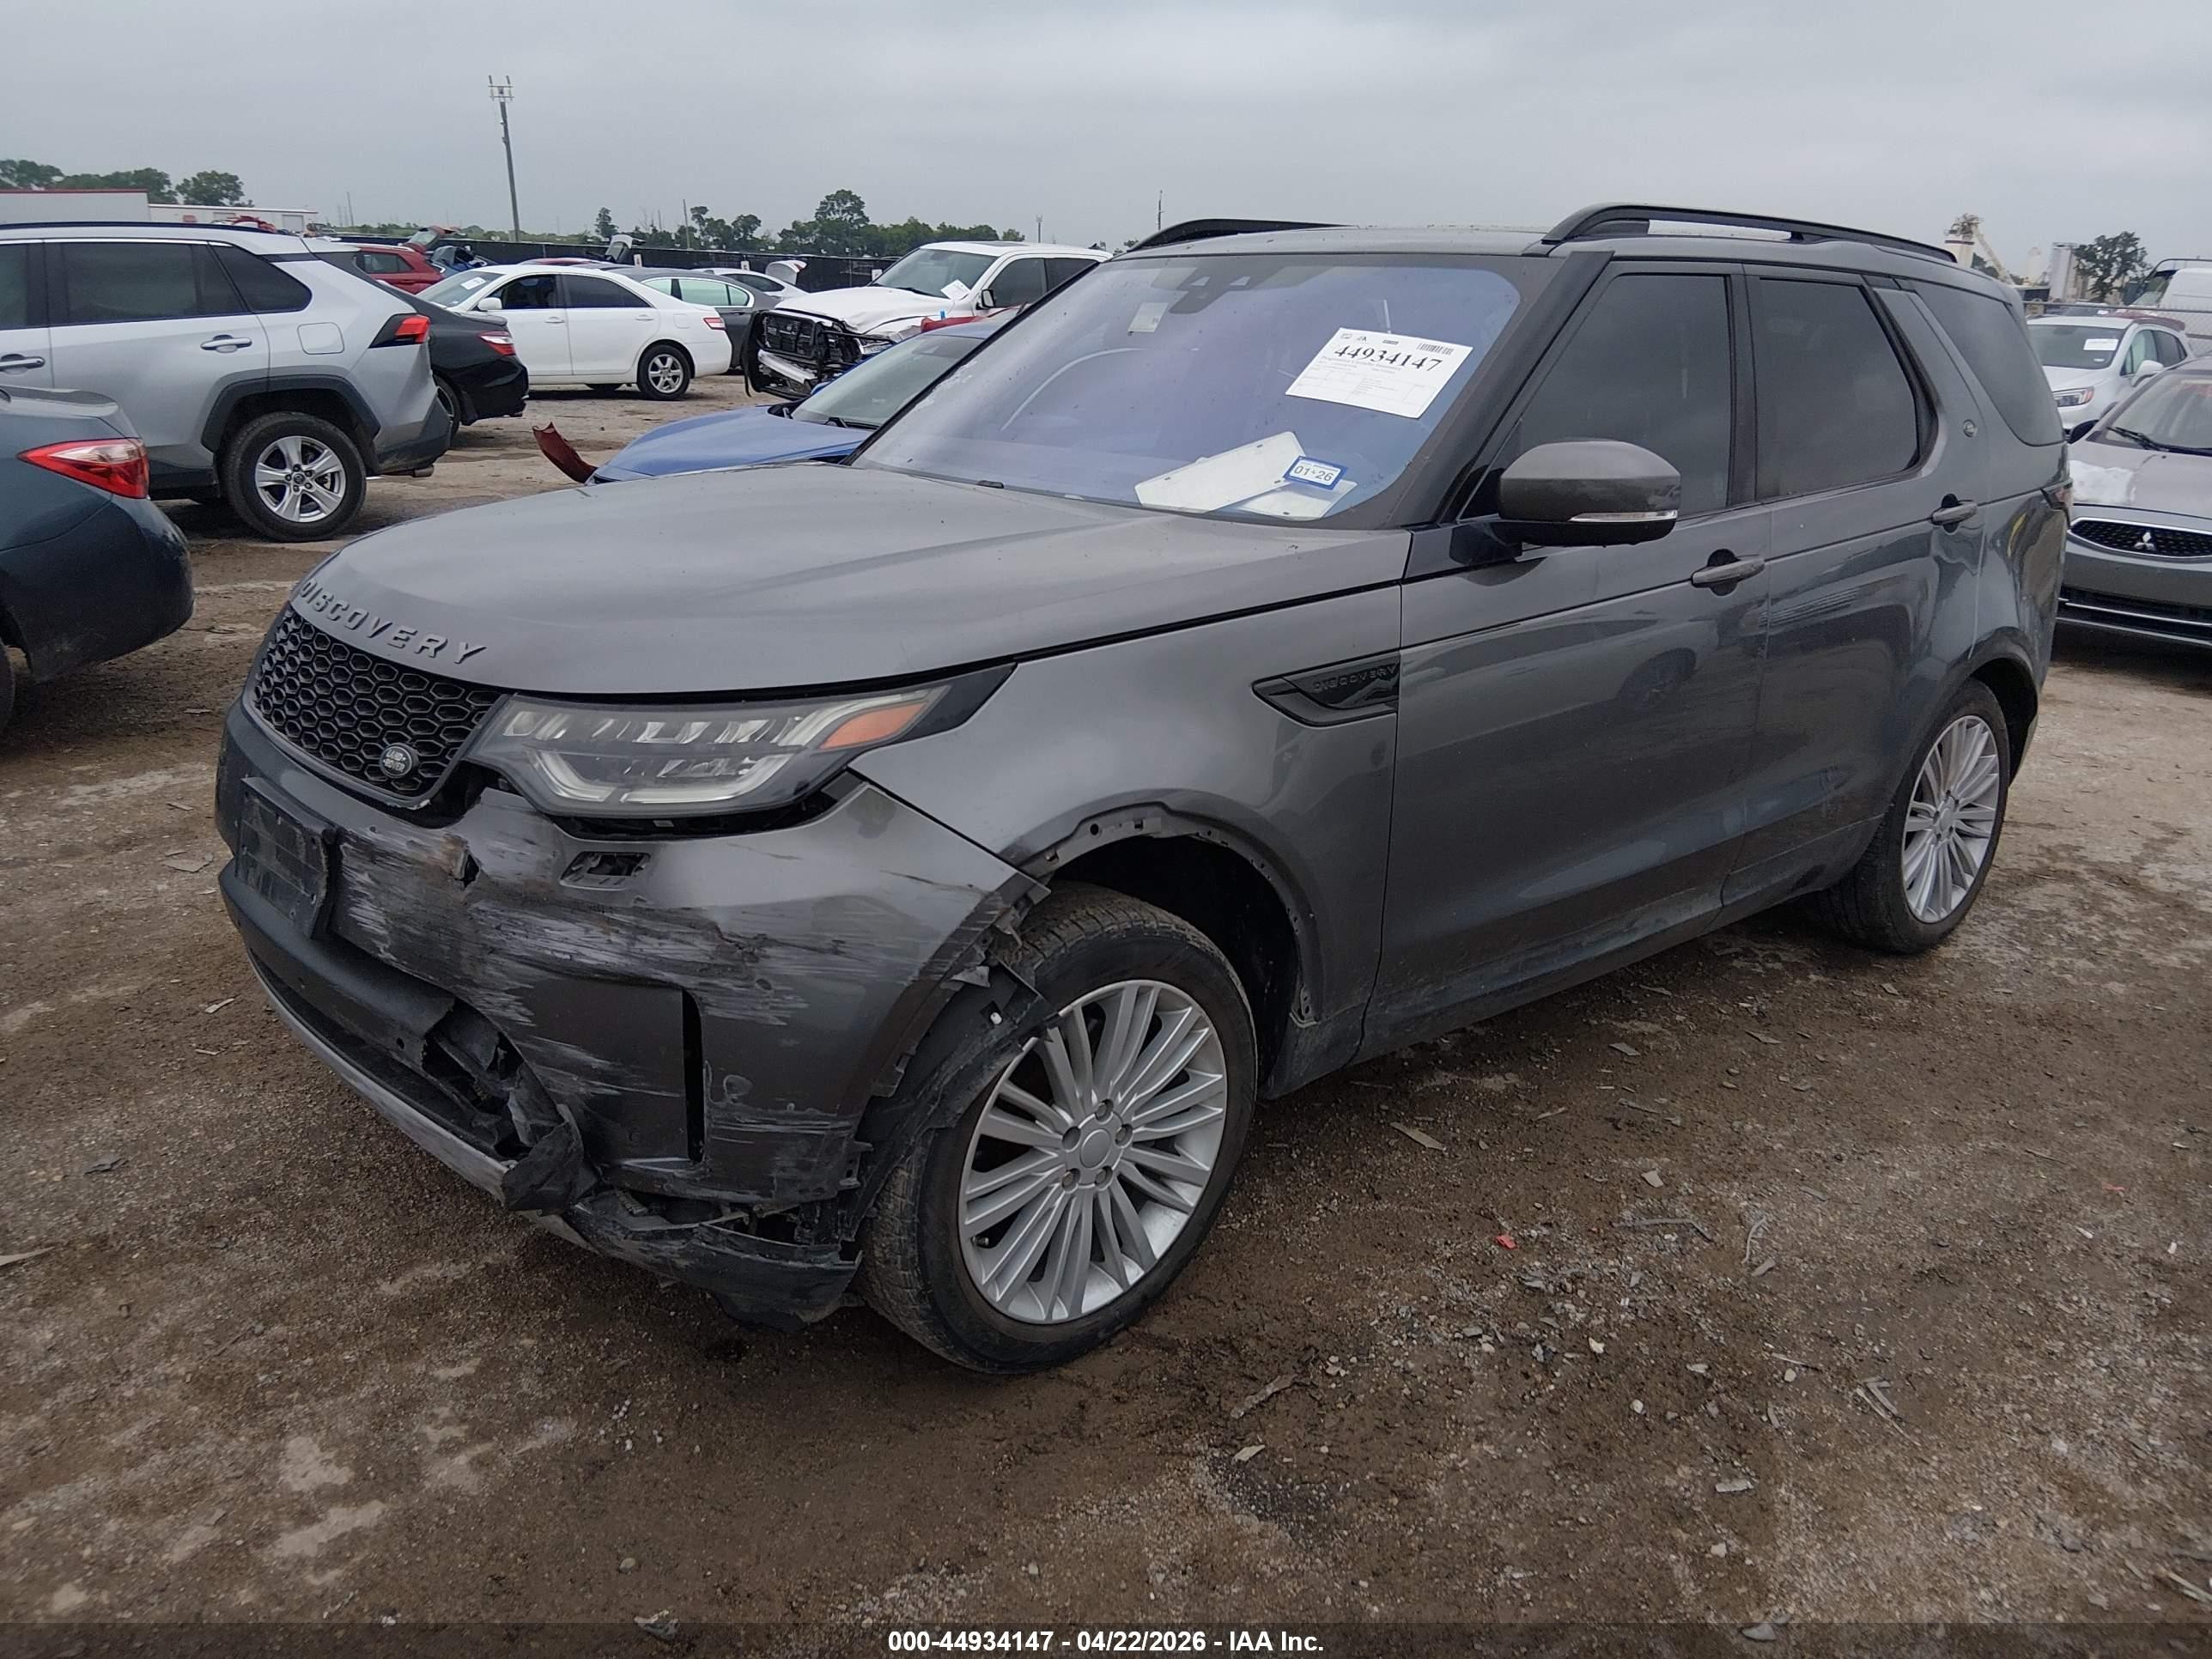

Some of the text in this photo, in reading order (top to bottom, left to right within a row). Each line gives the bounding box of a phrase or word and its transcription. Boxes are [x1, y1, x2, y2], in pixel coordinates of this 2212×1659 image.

[1334, 345, 1443, 371] 44934147
[300, 579, 487, 664] DISCOVERY
[1313, 661, 1398, 692] DISCOVERY
